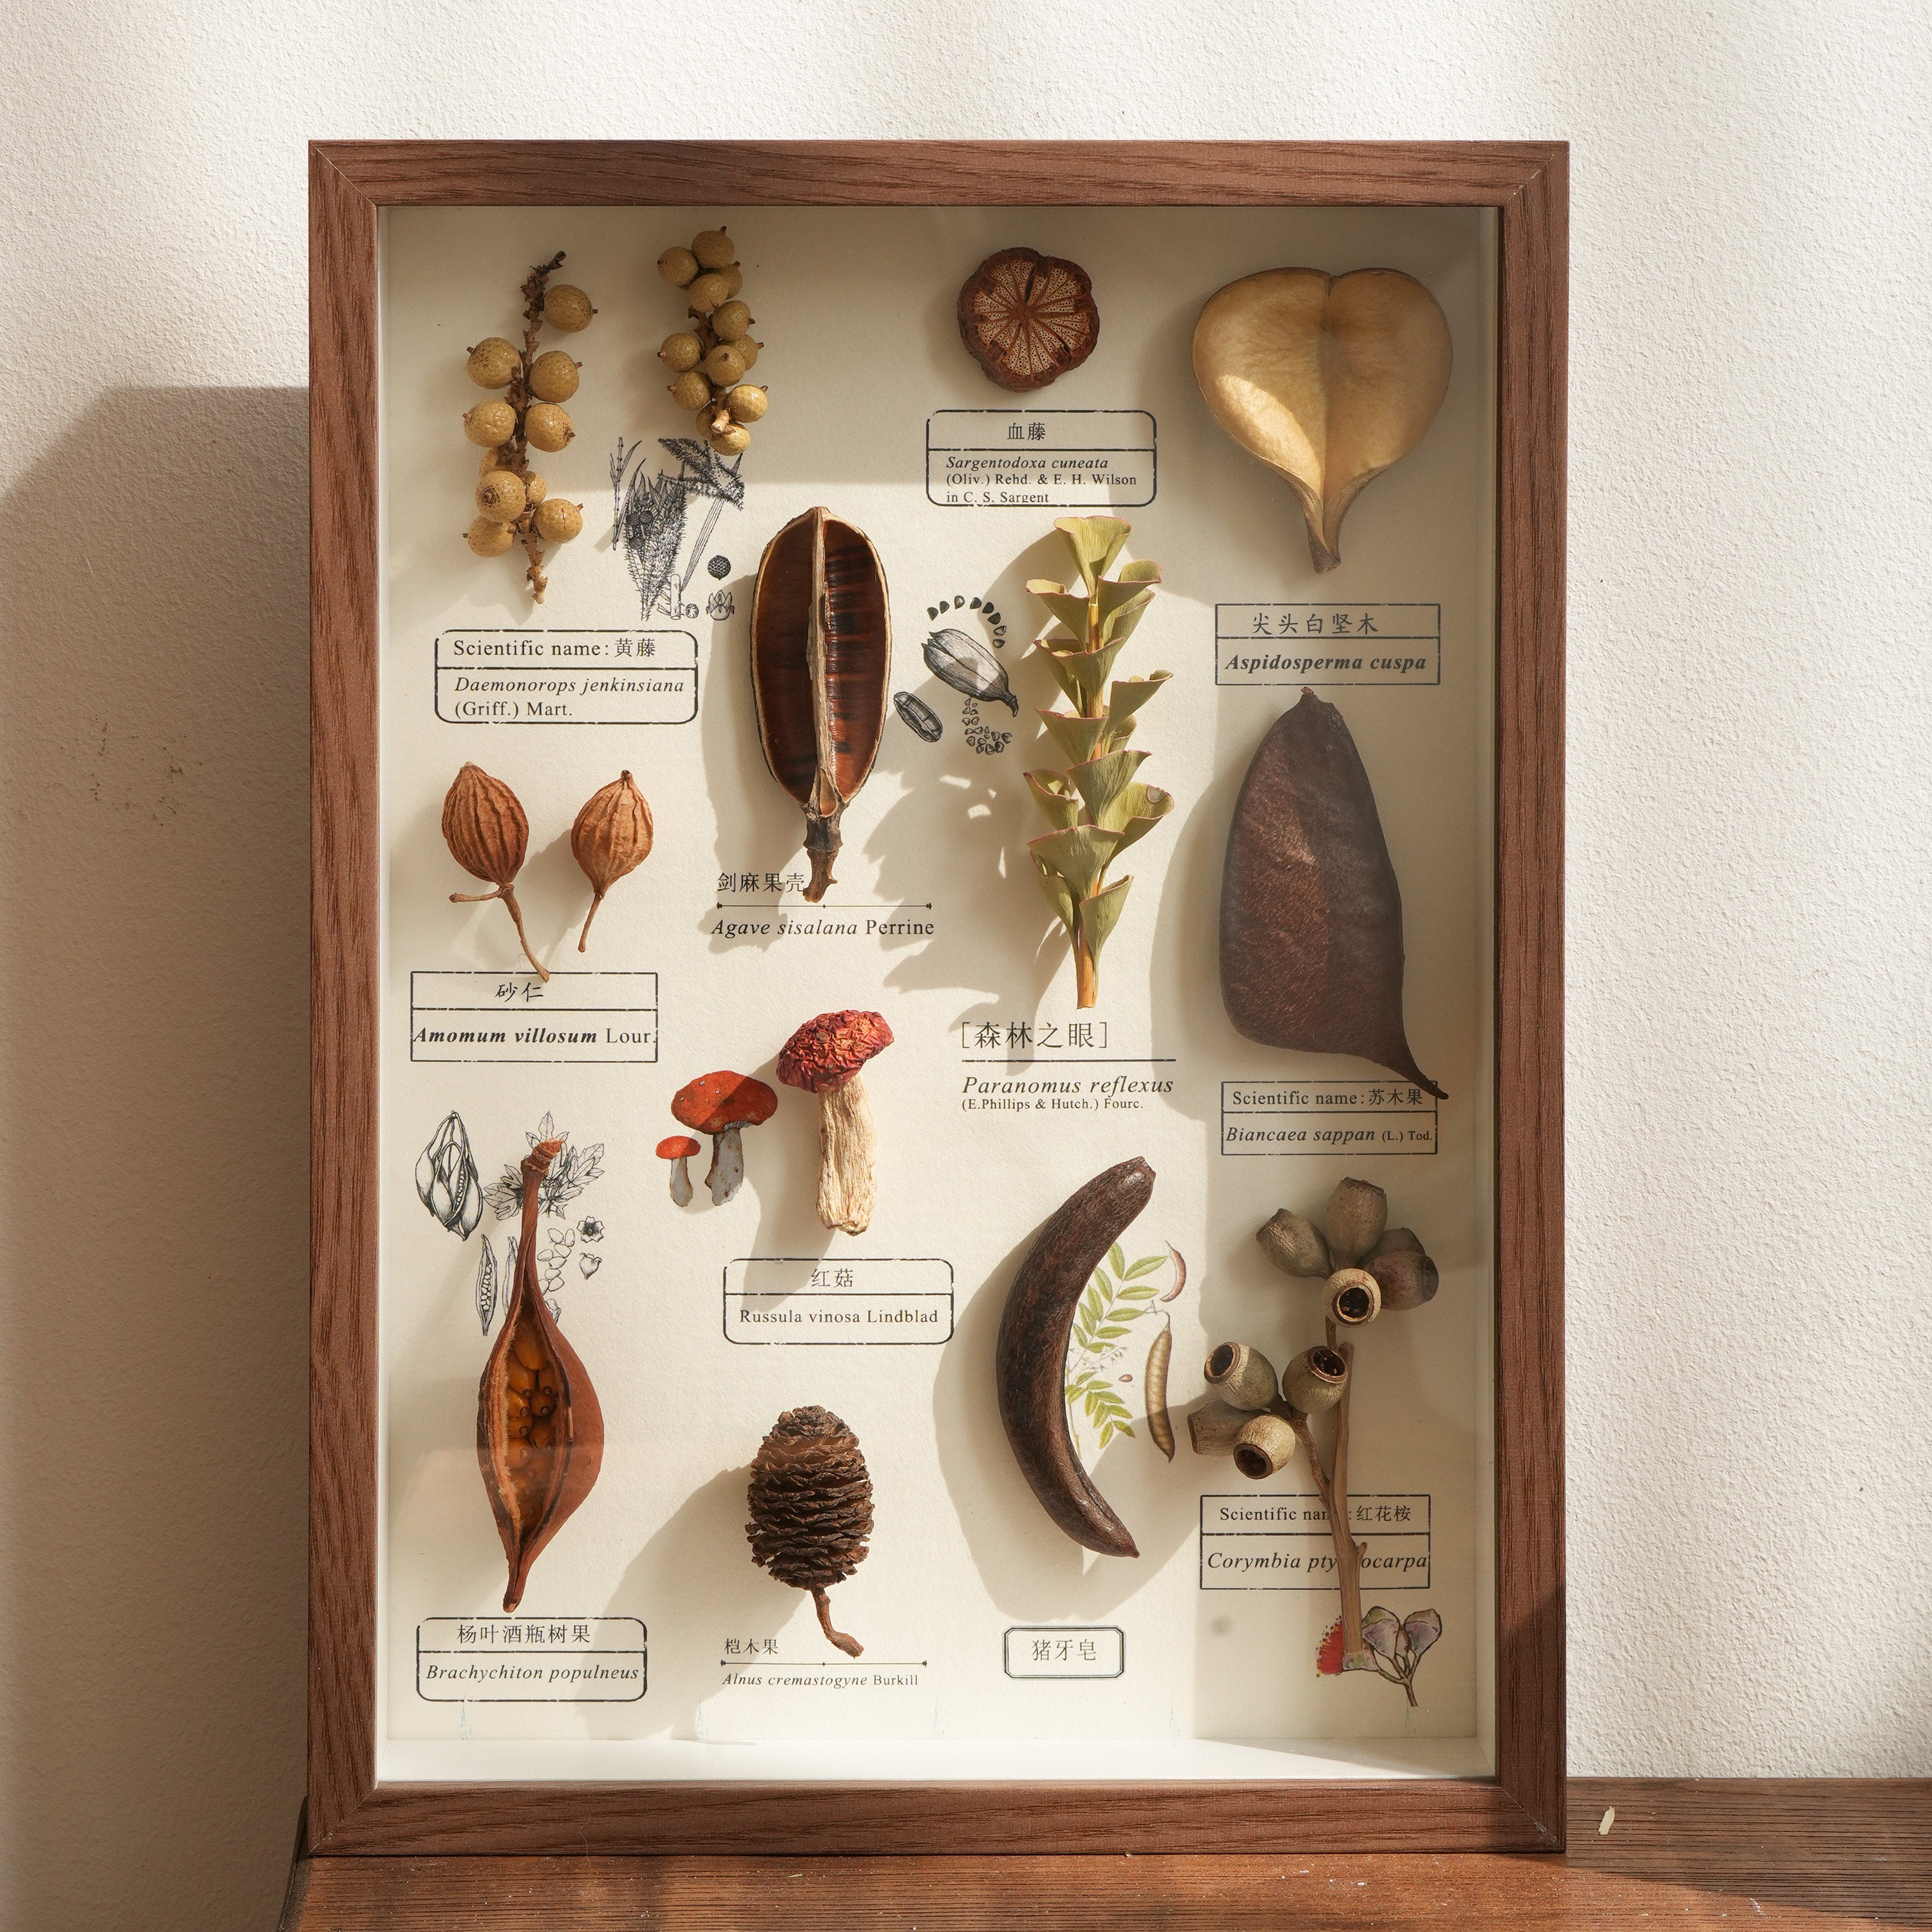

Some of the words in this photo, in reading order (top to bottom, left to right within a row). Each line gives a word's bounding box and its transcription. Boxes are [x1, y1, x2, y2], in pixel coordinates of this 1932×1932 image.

[1006, 422, 1046, 441] 血藤
[945, 456, 1046, 472] Sargentodoxa
[1051, 458, 1108, 469] cuneata
[946, 473, 990, 488] (Oliv.)
[994, 473, 1032, 485] Rehd.
[1036, 473, 1049, 485] &
[1053, 473, 1066, 485] E.
[1071, 473, 1086, 485] H.
[1091, 473, 1137, 485] Wilson
[946, 491, 958, 502] in
[963, 491, 975, 503] C.
[982, 491, 994, 503] S.
[1000, 491, 1049, 504] Sargent
[1252, 612, 1379, 636] 尖头白坚木
[453, 639, 544, 656] Scientific
[614, 638, 656, 658] 黄藤
[1224, 654, 1363, 674] Aspidosperma
[1369, 658, 1426, 674] cuspa
[453, 677, 576, 696] Daemonorops
[579, 677, 684, 696] jenkinsiana
[455, 701, 519, 720] (Griff.)
[526, 701, 573, 716] Mart.
[716, 871, 804, 893] 剑麻果壳
[710, 919, 771, 939] Agave
[777, 919, 857, 935] sisalana
[865, 919, 934, 935] Perrine
[494, 981, 544, 1003] 砂仁
[413, 1027, 506, 1043] Amomum
[514, 1027, 597, 1044] villosum
[961, 1076, 1081, 1094] Paranomus
[1090, 1075, 1173, 1098] reflexus
[961, 1098, 1030, 1112] (E.Phillips
[1035, 1098, 1046, 1110] &
[1051, 1098, 1099, 1112] Hutch.)
[1104, 1098, 1143, 1109] Fourc.
[1233, 1090, 1309, 1105] Scientific
[1368, 1088, 1423, 1106] 苏木果
[1225, 1127, 1307, 1142] Biancaea
[1312, 1130, 1376, 1145] sappan
[1381, 1130, 1404, 1144] (L.)
[1406, 1130, 1433, 1141] Tod.
[811, 1267, 853, 1288] 红菇
[739, 1309, 802, 1323] Russula
[808, 1309, 860, 1323] vinosa
[867, 1309, 938, 1323] Lindblad
[1220, 1506, 1297, 1521] Scientific
[1303, 1508, 1352, 1520] na:
[1356, 1504, 1411, 1522] 红花桉
[1208, 1551, 1301, 1573] Corymbia
[1306, 1554, 1427, 1573] ptyocarpa
[456, 1624, 591, 1644] 杨叶酒瓶树果
[723, 1638, 778, 1655] 桤木果
[1032, 1638, 1096, 1662] 猪牙皂
[426, 1664, 543, 1683] Brachychiton
[548, 1664, 639, 1683] populneus
[721, 1672, 762, 1685] Alnus
[768, 1676, 867, 1689] cremastogyne
[873, 1674, 918, 1685] Burkill
